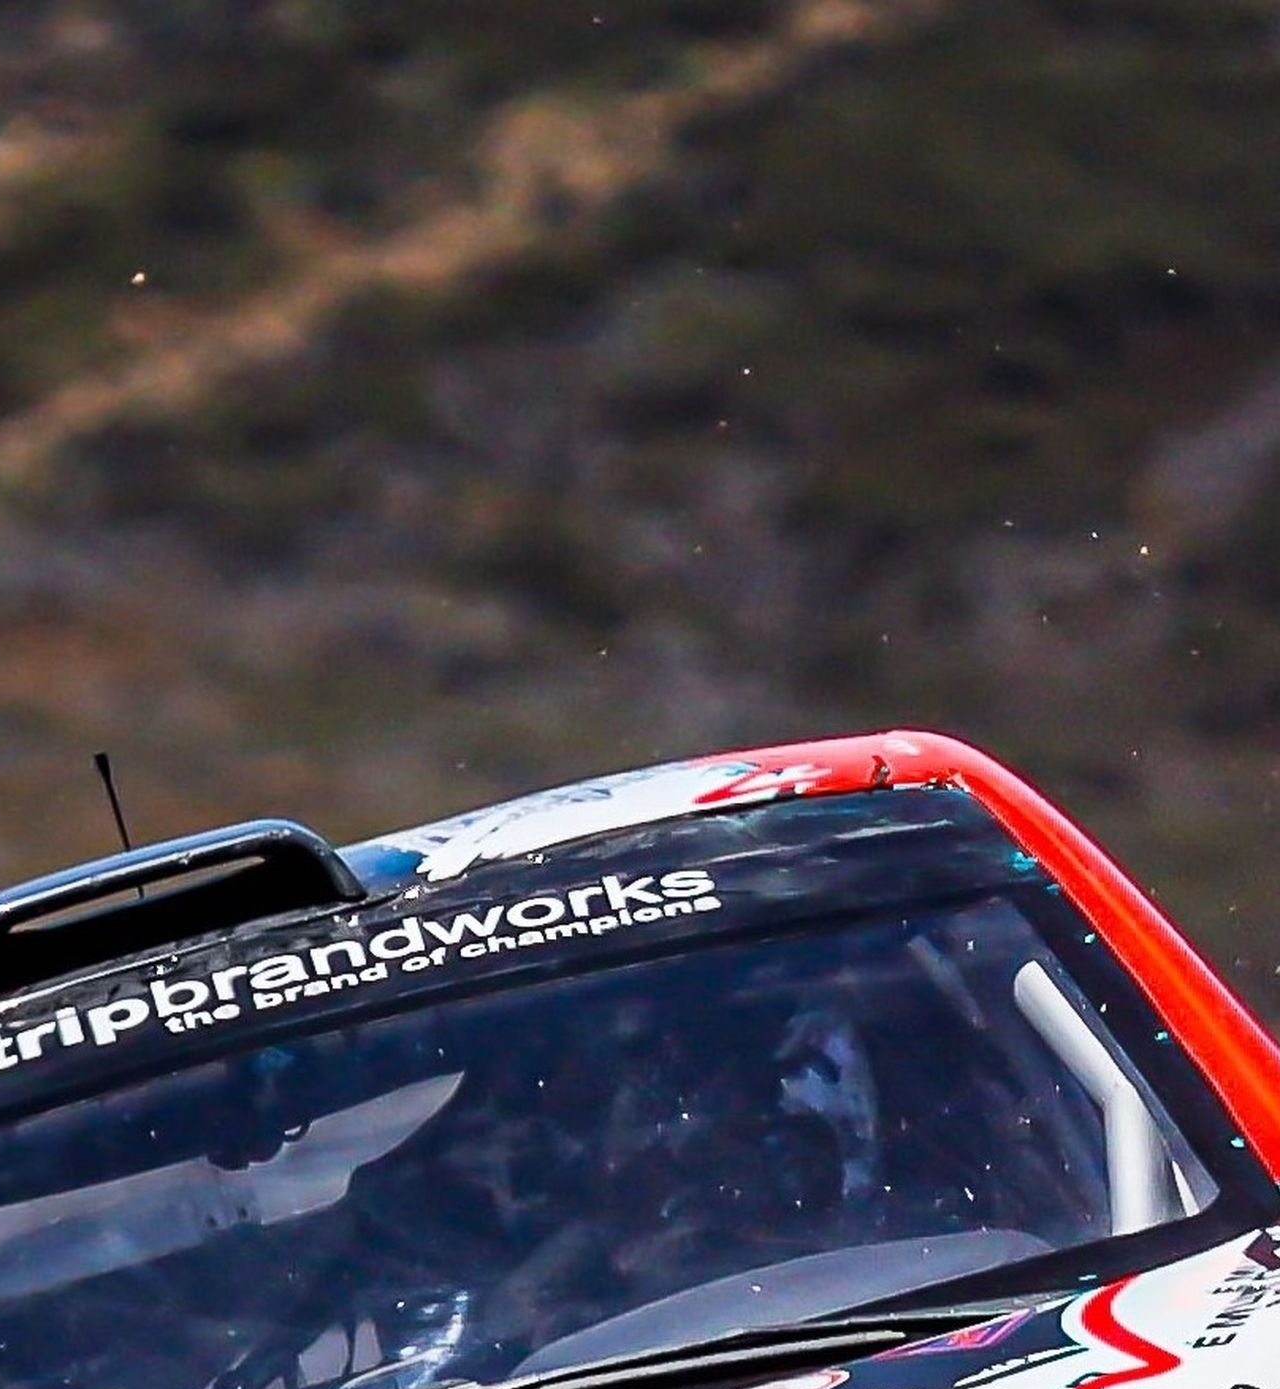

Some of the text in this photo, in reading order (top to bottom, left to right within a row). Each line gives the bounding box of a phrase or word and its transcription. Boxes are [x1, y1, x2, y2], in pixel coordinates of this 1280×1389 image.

[164, 896, 721, 1034] the brand of champions
